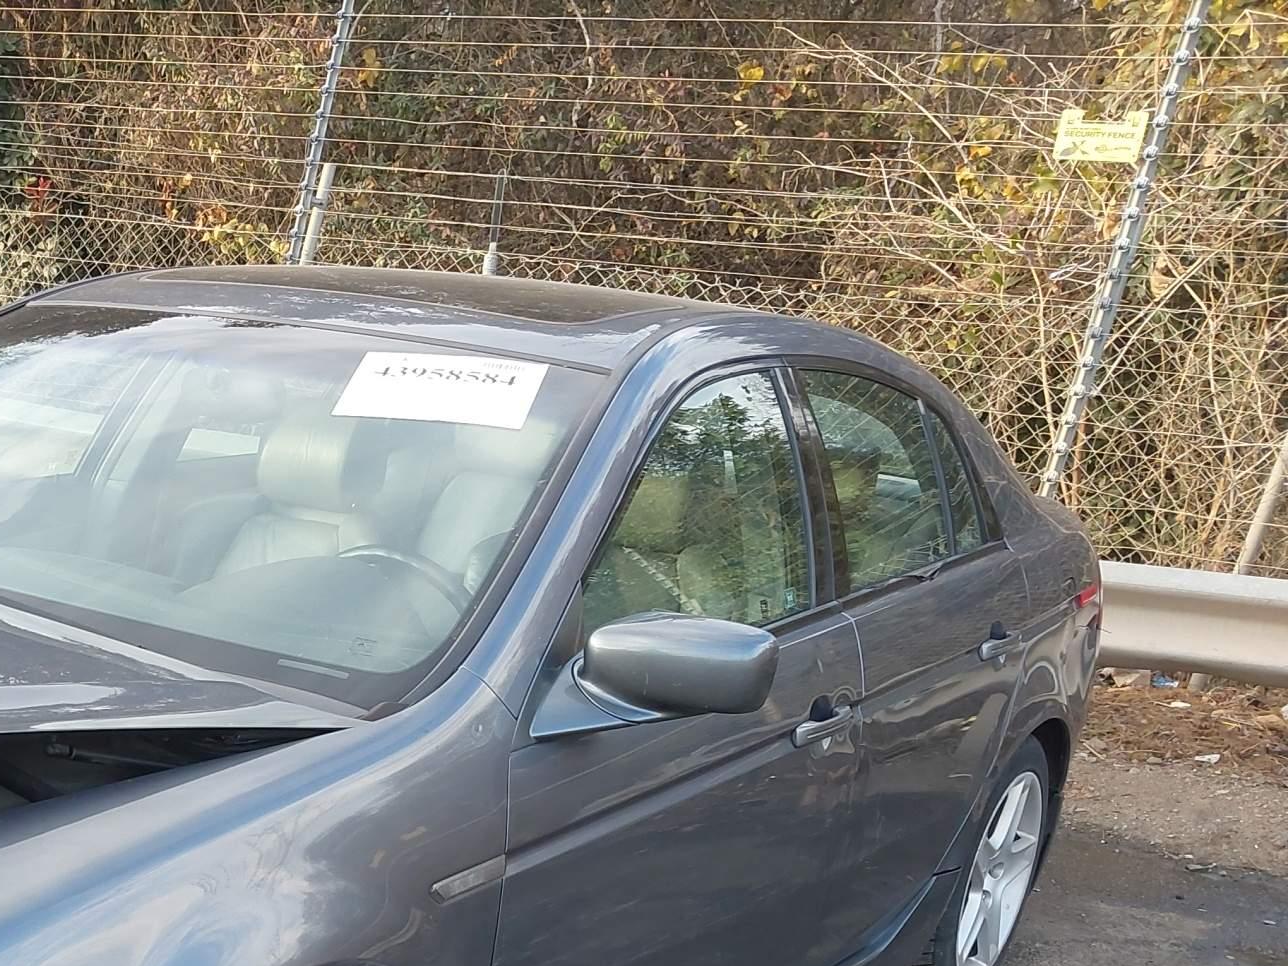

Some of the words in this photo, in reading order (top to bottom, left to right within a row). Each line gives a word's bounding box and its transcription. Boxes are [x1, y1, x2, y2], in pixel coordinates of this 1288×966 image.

[1063, 130, 1106, 138] SECURITY
[1107, 131, 1137, 139] FENCE
[373, 365, 517, 387] 43958584
